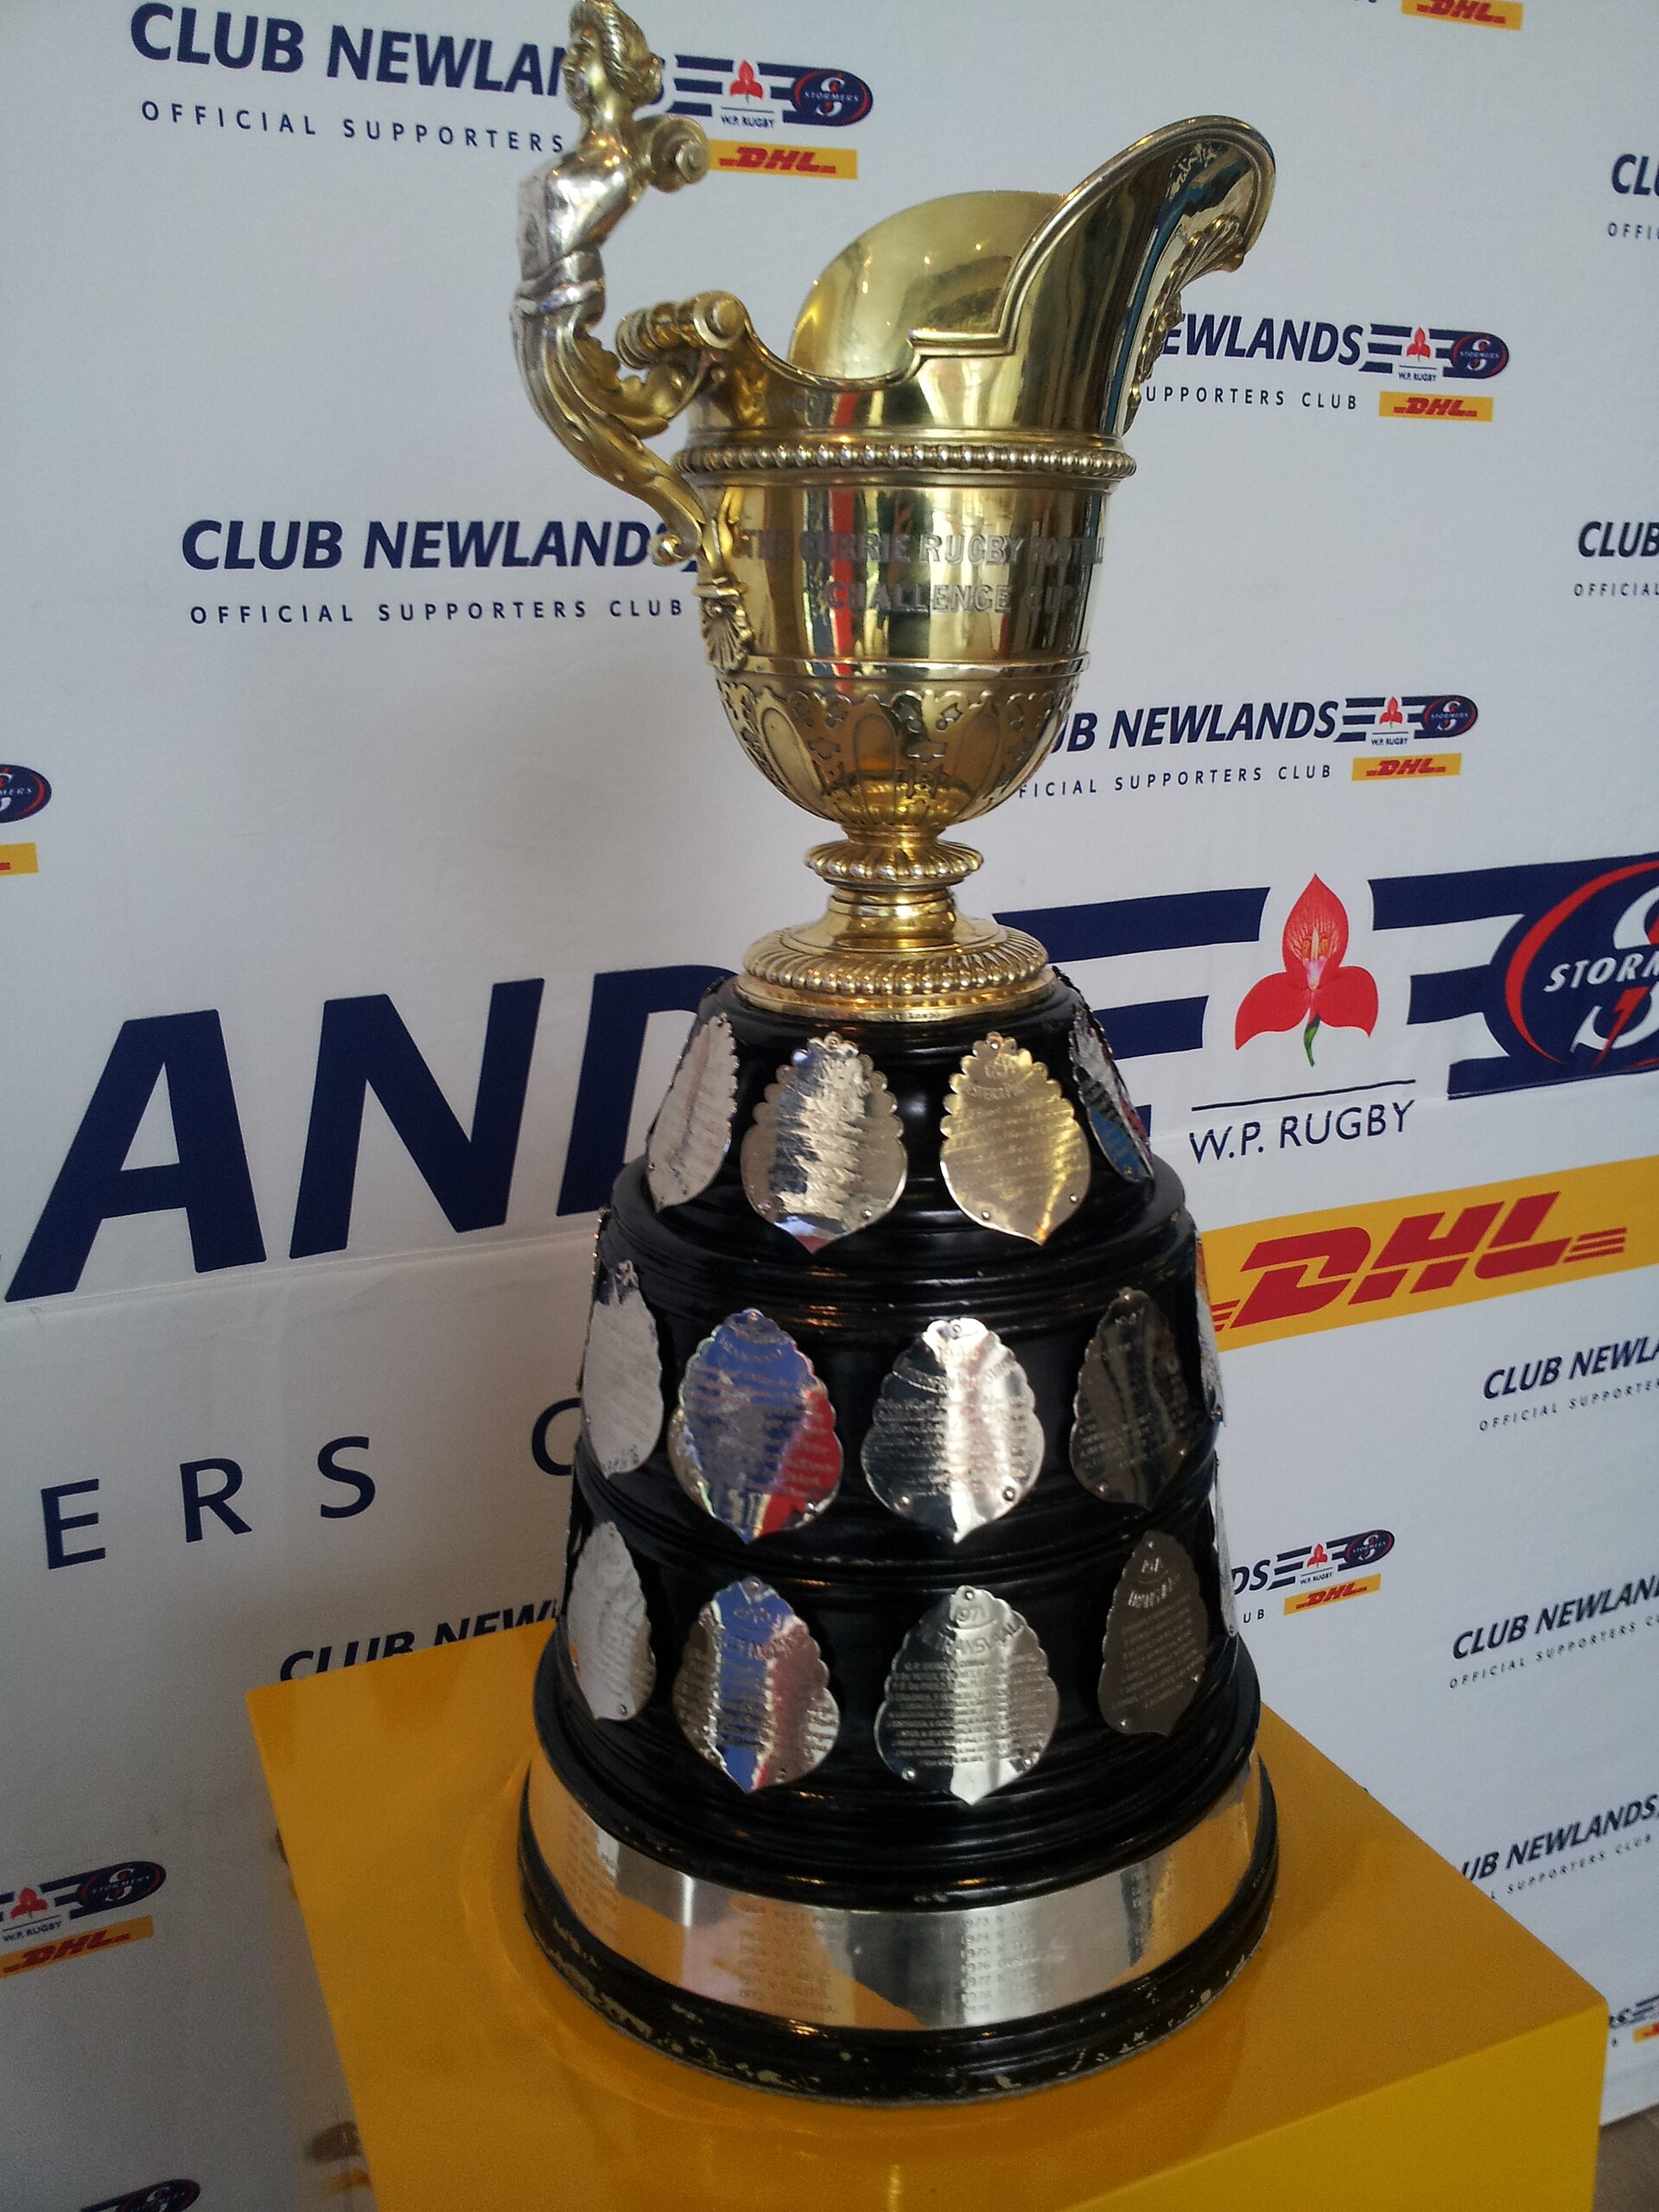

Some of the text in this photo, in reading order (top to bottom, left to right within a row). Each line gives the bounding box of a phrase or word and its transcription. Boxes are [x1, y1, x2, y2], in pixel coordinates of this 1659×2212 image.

[130, 3, 567, 97] CLUB NEWLA
[142, 101, 563, 153] OFFICIAL SUPPORTERS
[742, 116, 774, 129] RUGBY
[719, 147, 836, 174] DHL
[1608, 222, 1659, 240] OFFI
[1161, 314, 1364, 365] EWLANDS
[1414, 372, 1437, 382] RUGBY
[1146, 385, 1357, 410] UPPORTERS CLUB
[1393, 397, 1478, 417] DHL
[181, 520, 667, 571] CLUB NEWLAND
[918, 532, 1025, 565] RUGBY
[1578, 521, 1659, 558] CLUB
[190, 599, 682, 626] OFFICIAL SUPPORTERS CLUB
[823, 581, 1013, 613] CHALLENGE
[1109, 700, 1339, 750] NEWLANDS
[1385, 737, 1408, 746] RUGBY
[1019, 764, 1331, 798] FICIAL SUPPORTERS CLUB
[1366, 758, 1446, 777] DHL
[1188, 1099, 1415, 1165] W.P. RUGBY
[1230, 1192, 1574, 1329] DHL
[1483, 1356, 1562, 1400] CLUB
[1478, 1402, 1558, 1432] OFFICIAL
[1295, 1582, 1367, 1610] DHL
[1452, 1574, 1659, 1660] CLUB NEWLAN
[1449, 1657, 1526, 1689] OFFICIAL
[1535, 1621, 1637, 1662] SUPPORTERS
[1505, 1793, 1659, 1869] NEWLANDS
[3, 1929, 131, 1974] DHL
